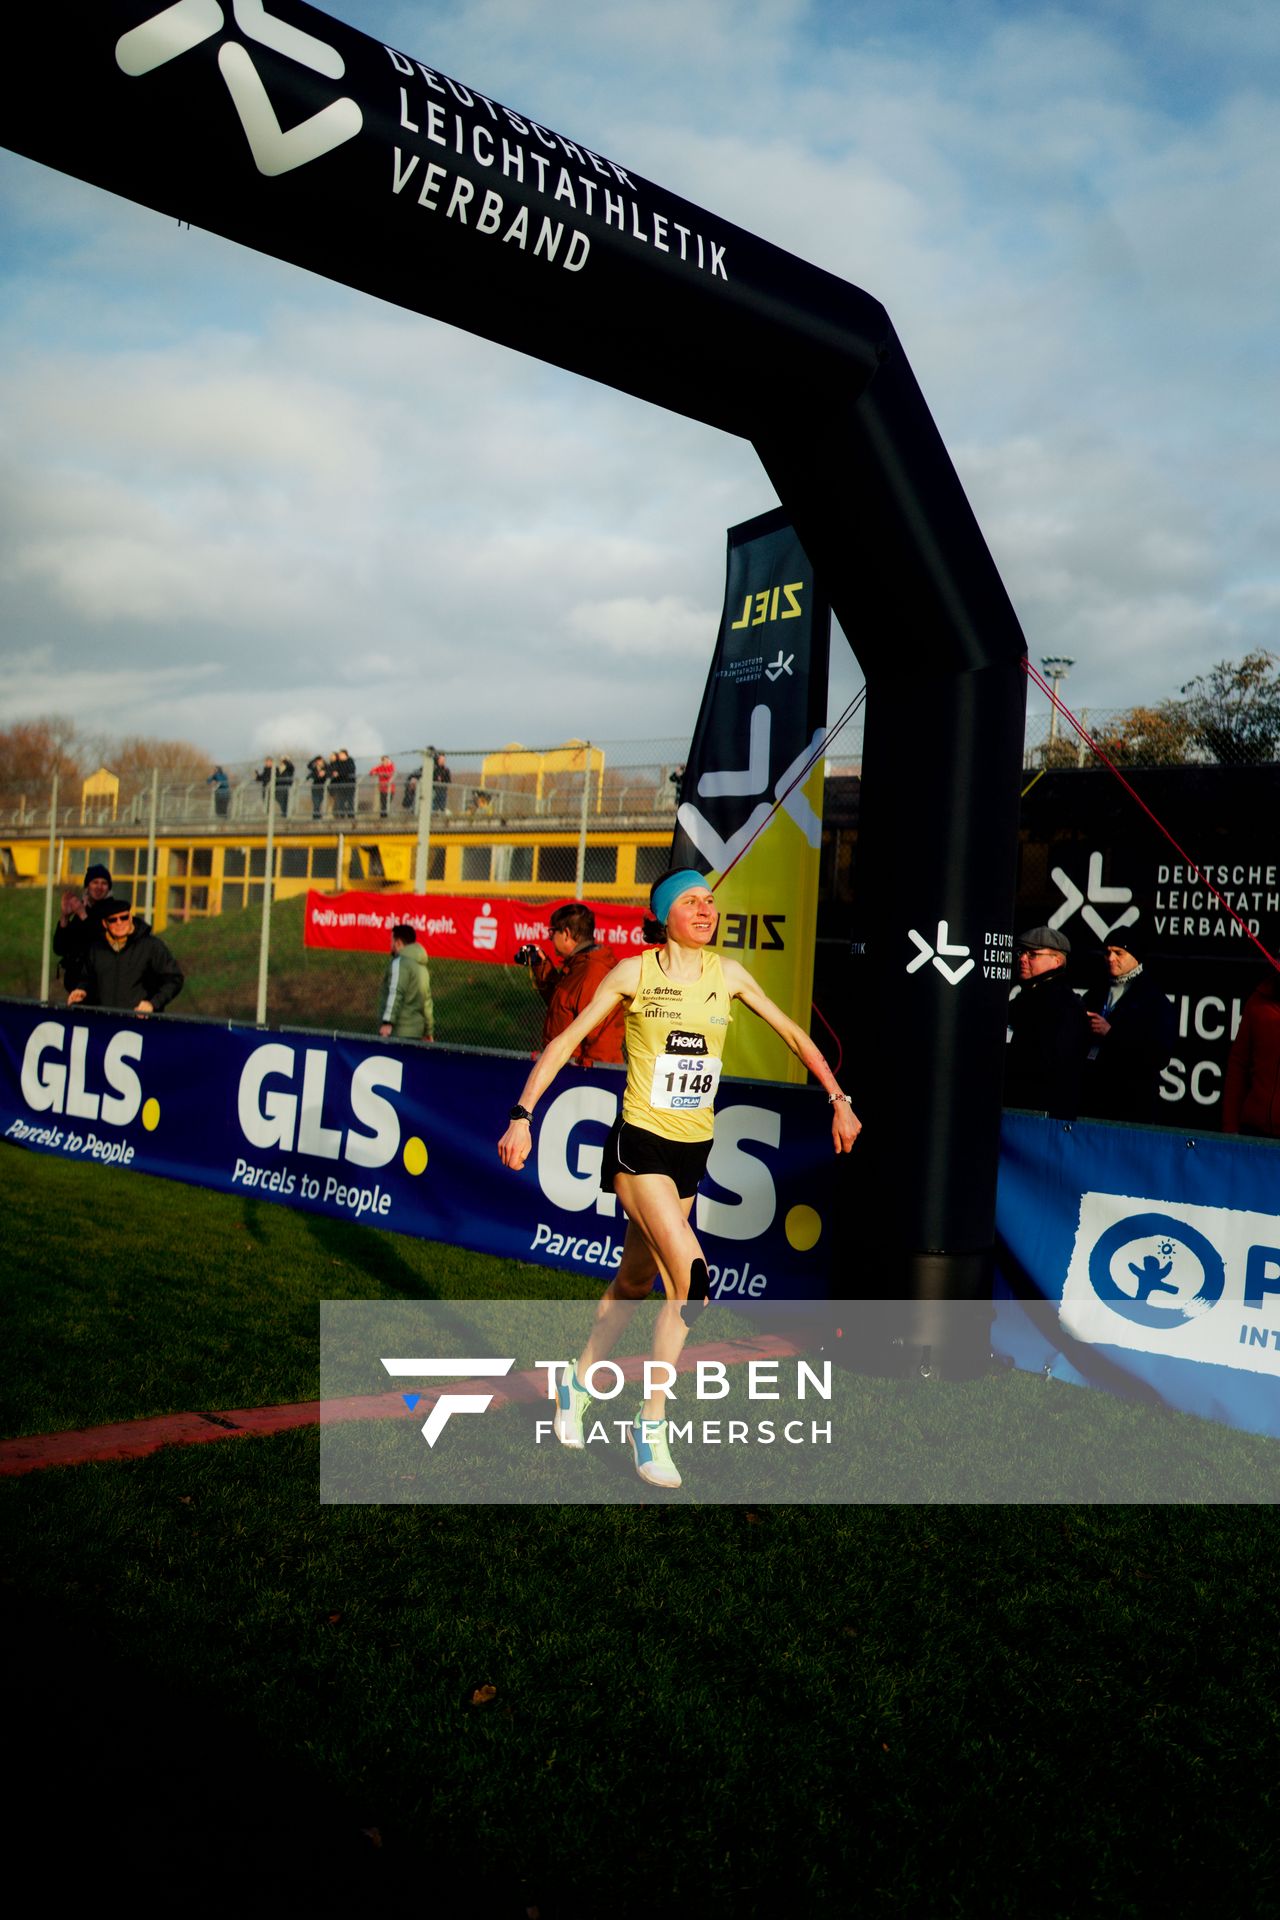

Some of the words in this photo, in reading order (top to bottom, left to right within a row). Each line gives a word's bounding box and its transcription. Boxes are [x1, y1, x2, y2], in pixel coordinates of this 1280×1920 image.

[384, 46, 637, 191] DEUTSCHER
[400, 87, 728, 281] LEICHTATHLETIK
[392, 146, 590, 272] VERBAND
[1158, 865, 1277, 885] DEUTSCHE
[1156, 890, 1280, 912] LEICHTATH
[1154, 915, 1261, 938] VERBAND
[645, 1008, 682, 1019] infinex
[670, 1036, 703, 1049] HOKA
[677, 1059, 704, 1071] GLS
[665, 1072, 713, 1094] 1148
[6, 1119, 63, 1147] Parcels
[64, 1131, 83, 1152] to
[81, 1133, 134, 1165] People
[232, 1158, 296, 1194] Parcels
[300, 1174, 319, 1199] to
[323, 1177, 391, 1217] People
[530, 1223, 624, 1268] Parcels
[709, 1262, 767, 1300] ople
